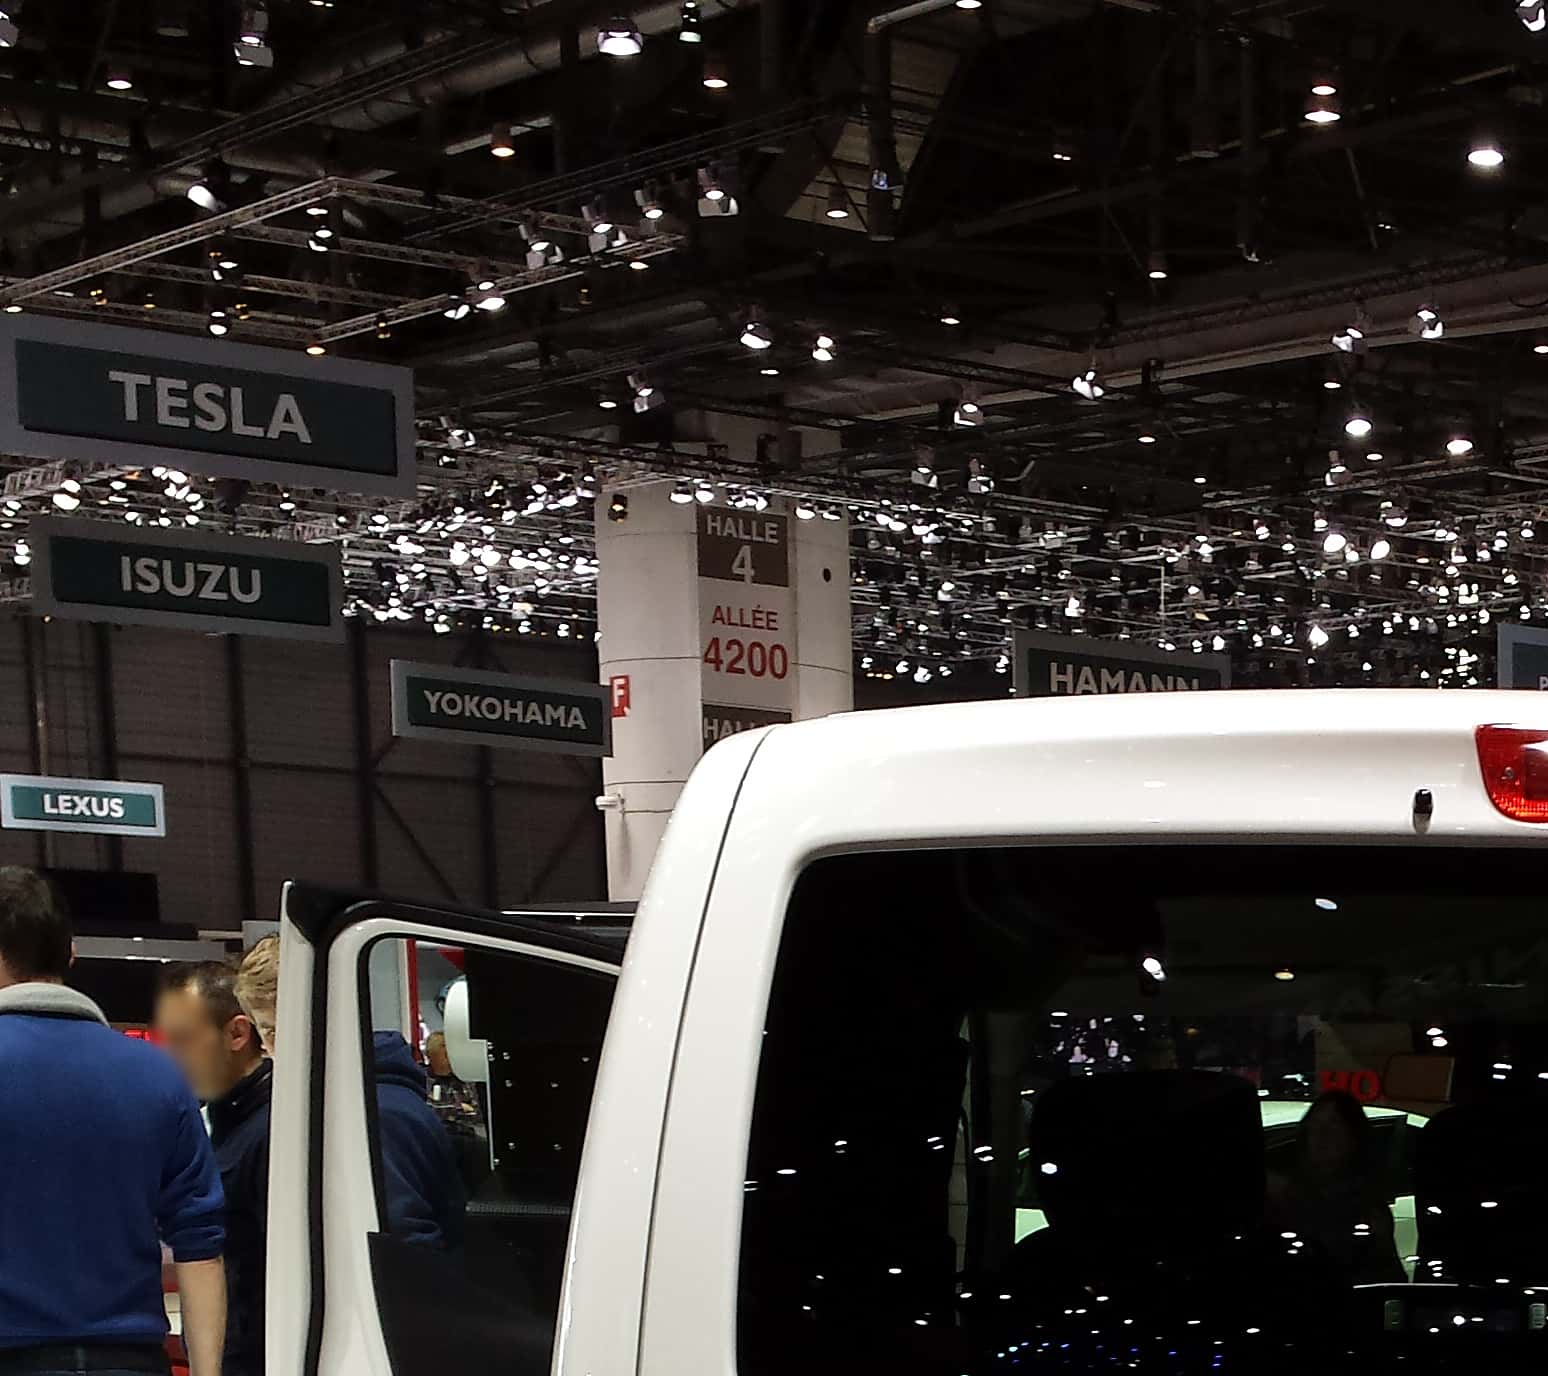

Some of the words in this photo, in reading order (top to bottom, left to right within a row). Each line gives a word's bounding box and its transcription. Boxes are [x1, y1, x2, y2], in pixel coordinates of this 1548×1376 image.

[107, 370, 312, 445] TESLA
[706, 514, 779, 544] HALLE
[120, 555, 263, 604] ISUZU
[731, 545, 755, 586] 4
[711, 605, 779, 631] ALLÉE
[703, 637, 789, 680] 4200
[423, 690, 587, 730] YOKOHAMA
[612, 677, 626, 708] F
[43, 794, 125, 820] LEXUS
